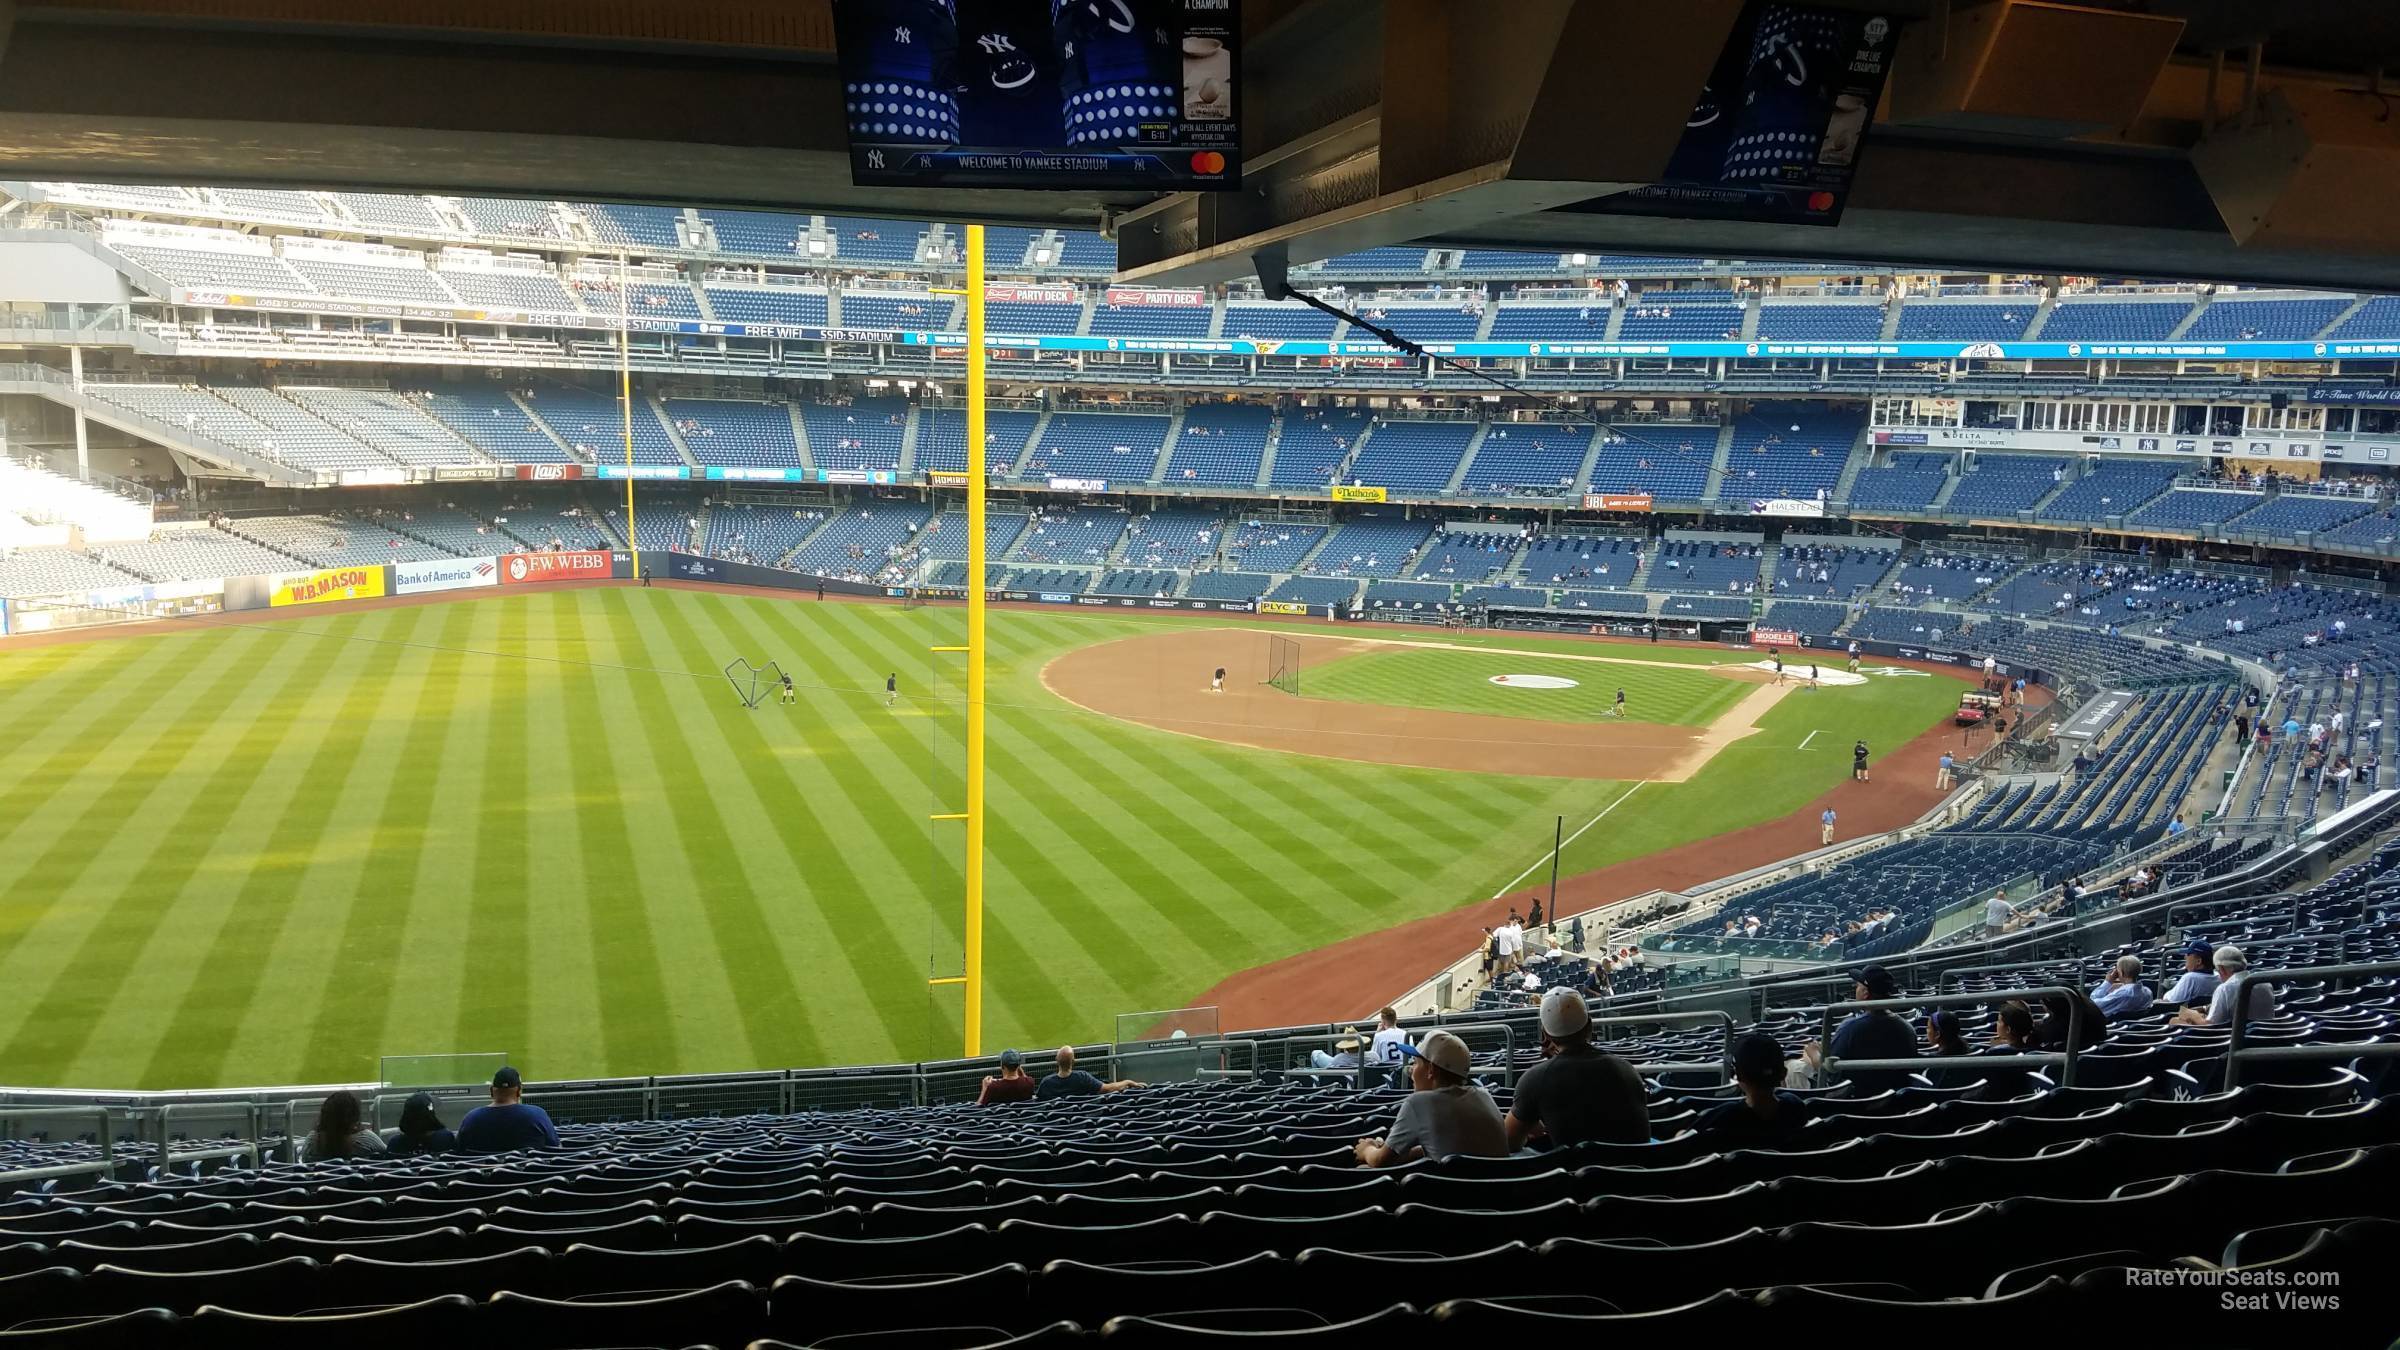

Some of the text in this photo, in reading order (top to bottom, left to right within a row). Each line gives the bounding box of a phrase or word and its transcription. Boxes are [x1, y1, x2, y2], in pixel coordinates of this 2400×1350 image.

[959, 156, 1108, 170] WELCOME TO YANKEE STADIUM
[1628, 186, 1748, 201] WELCOME TO YANKEE STADIUM
[1017, 288, 1045, 300] PARTY
[1046, 290, 1068, 301] DECK
[1145, 292, 1173, 303] PARTY
[1174, 293, 1197, 304] DECK
[292, 301, 326, 310] CARVING
[420, 309, 435, 317] AND
[528, 313, 586, 327] FREE WIFI
[633, 320, 680, 332] STADIUM
[745, 325, 802, 339] FREE WIFI
[849, 331, 894, 343] STADIUM
[2313, 388, 2353, 400] 27-Time
[2356, 389, 2387, 400] World
[478, 469, 493, 477] TEA
[1337, 487, 1380, 498] Nathan's
[1586, 496, 1606, 509] JBL
[1772, 502, 1822, 512] HALSTEAD
[556, 554, 604, 569] WEBB
[397, 570, 471, 586] Bank of America
[1041, 593, 1072, 601] GEICO
[1263, 602, 1305, 612] PLYCN
[1755, 632, 1794, 640] MODELL'S
[1387, 1041, 1401, 1060] 2
